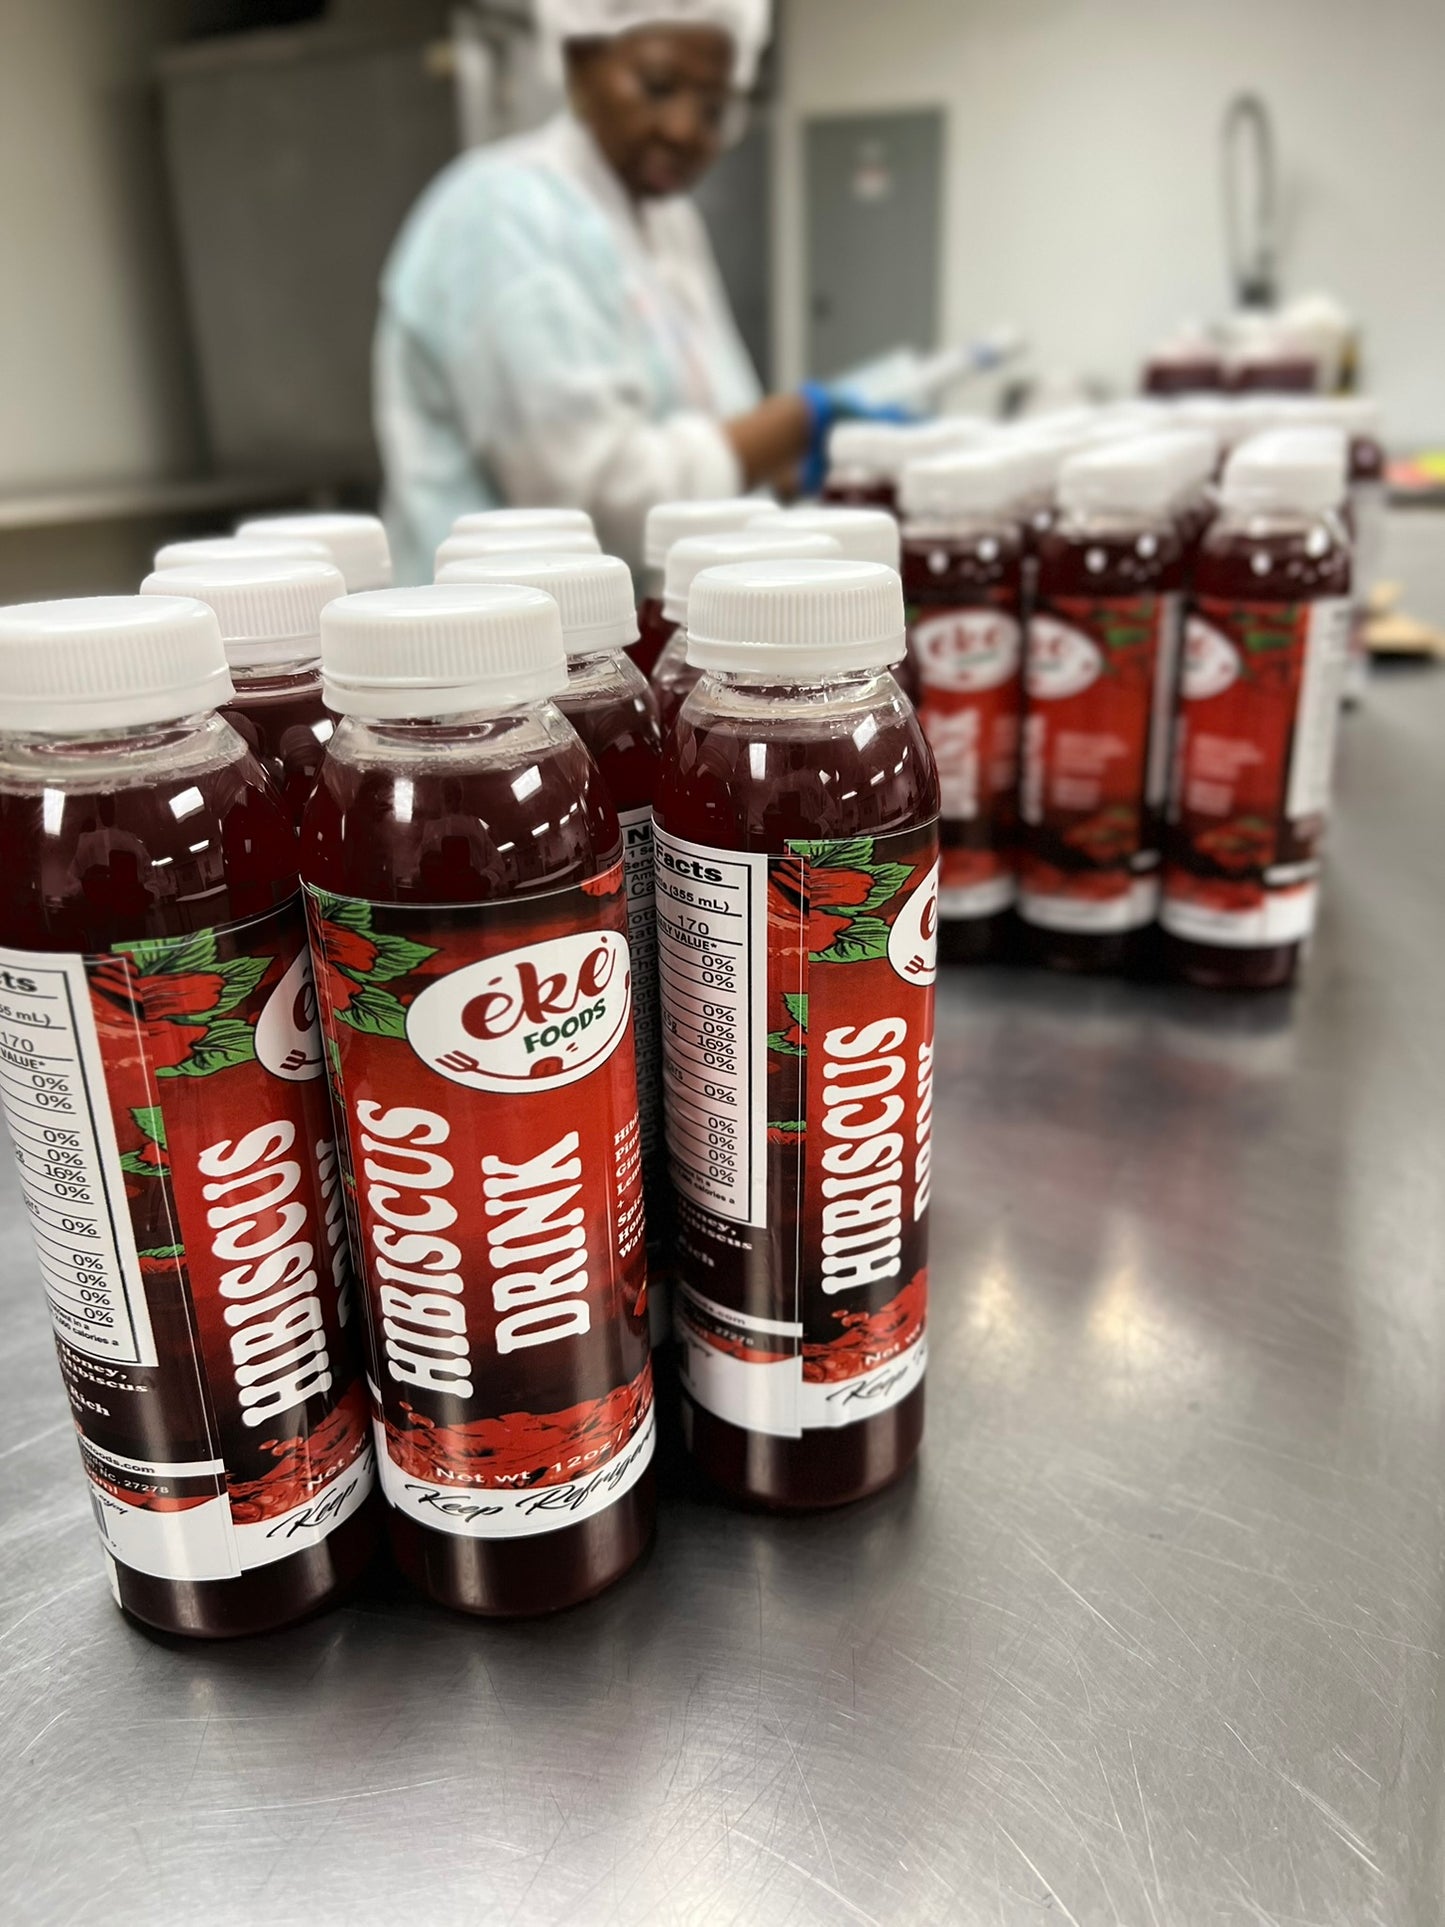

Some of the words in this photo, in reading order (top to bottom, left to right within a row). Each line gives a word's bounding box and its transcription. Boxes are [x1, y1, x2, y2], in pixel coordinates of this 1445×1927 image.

[655, 842, 723, 882] Facts
[669, 884, 694, 903] (355
[698, 897, 730, 913] mL)
[677, 914, 710, 936] 170
[702, 954, 734, 972] 0%
[702, 971, 734, 989] 0%
[16, 1010, 52, 1027] mL)
[703, 1004, 735, 1022] 0%
[523, 998, 606, 1054] FOODS
[703, 1021, 735, 1039] 0%
[1, 1031, 35, 1053] 170
[697, 1034, 734, 1055] 16%
[703, 1052, 735, 1070] 0%
[32, 1074, 69, 1092] 0%
[36, 1093, 72, 1110] 0%
[704, 1084, 735, 1103] 0%
[708, 1117, 735, 1134] 0%
[43, 1130, 79, 1147] 0%
[708, 1133, 735, 1151] 0%
[47, 1149, 83, 1166] 0%
[709, 1149, 735, 1167] 0%
[821, 1017, 907, 1294] HIBISCUS
[43, 1164, 86, 1184] 16%
[709, 1165, 735, 1183] 0%
[54, 1183, 90, 1201] 0%
[62, 1218, 97, 1236] 0%
[356, 1100, 474, 1399] HIBISCUS
[481, 1130, 591, 1354] DRINK
[73, 1254, 103, 1270] 0%
[76, 1271, 107, 1288] 0%
[198, 1120, 332, 1428] HIBISCUS
[80, 1289, 110, 1306] 0%
[84, 1307, 114, 1323] 0%
[72, 1327, 109, 1345] calories
[69, 1384, 111, 1417] Rich
[436, 1466, 485, 1484] Net
[494, 1470, 531, 1484] wt
[550, 1440, 612, 1473] 12oz
[307, 1458, 345, 1492] Net
[124, 1479, 170, 1494] 27278
[266, 1478, 359, 1538] Keep
[404, 1483, 504, 1523] Keep
